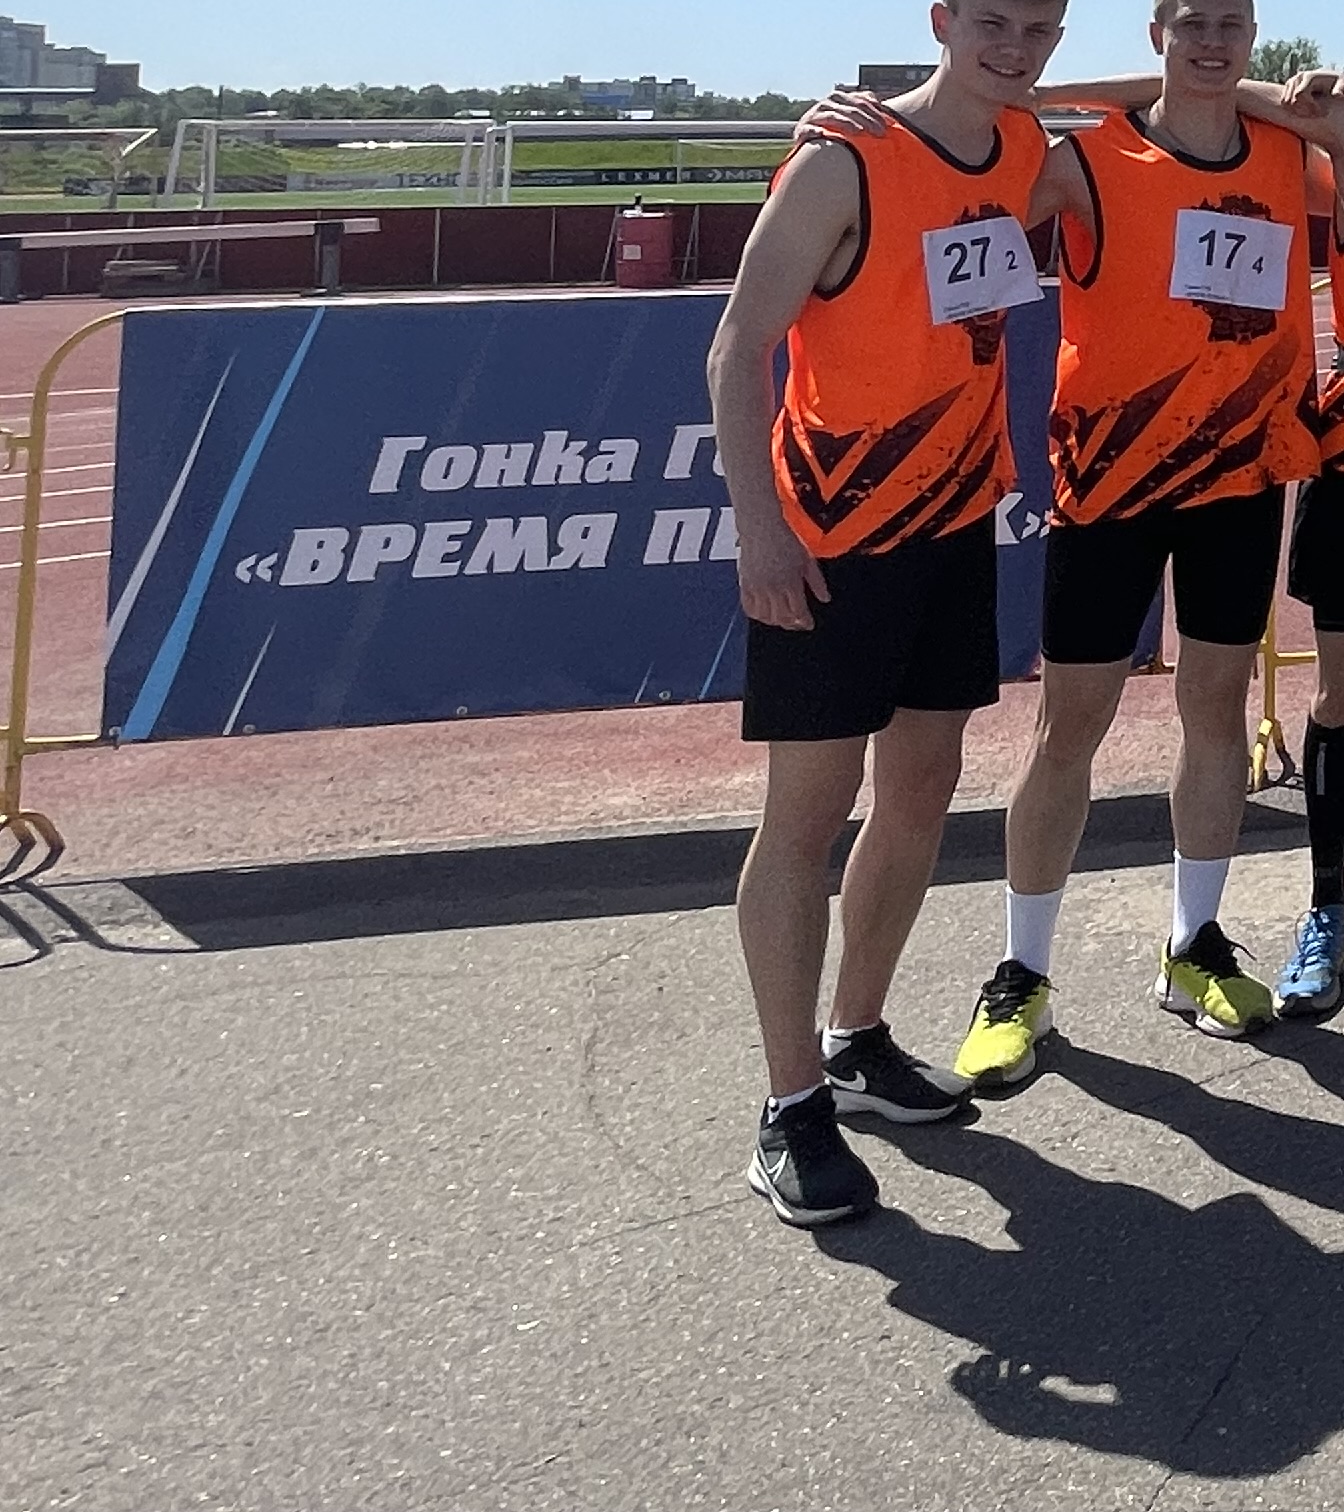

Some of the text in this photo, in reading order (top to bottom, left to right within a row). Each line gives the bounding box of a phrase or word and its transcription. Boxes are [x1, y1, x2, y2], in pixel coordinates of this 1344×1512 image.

[944, 236, 1018, 285] 27 2
[1198, 229, 1264, 274] 17 4
[369, 430, 639, 493] Гонка
[234, 513, 618, 586] «ВРЕМЯ
